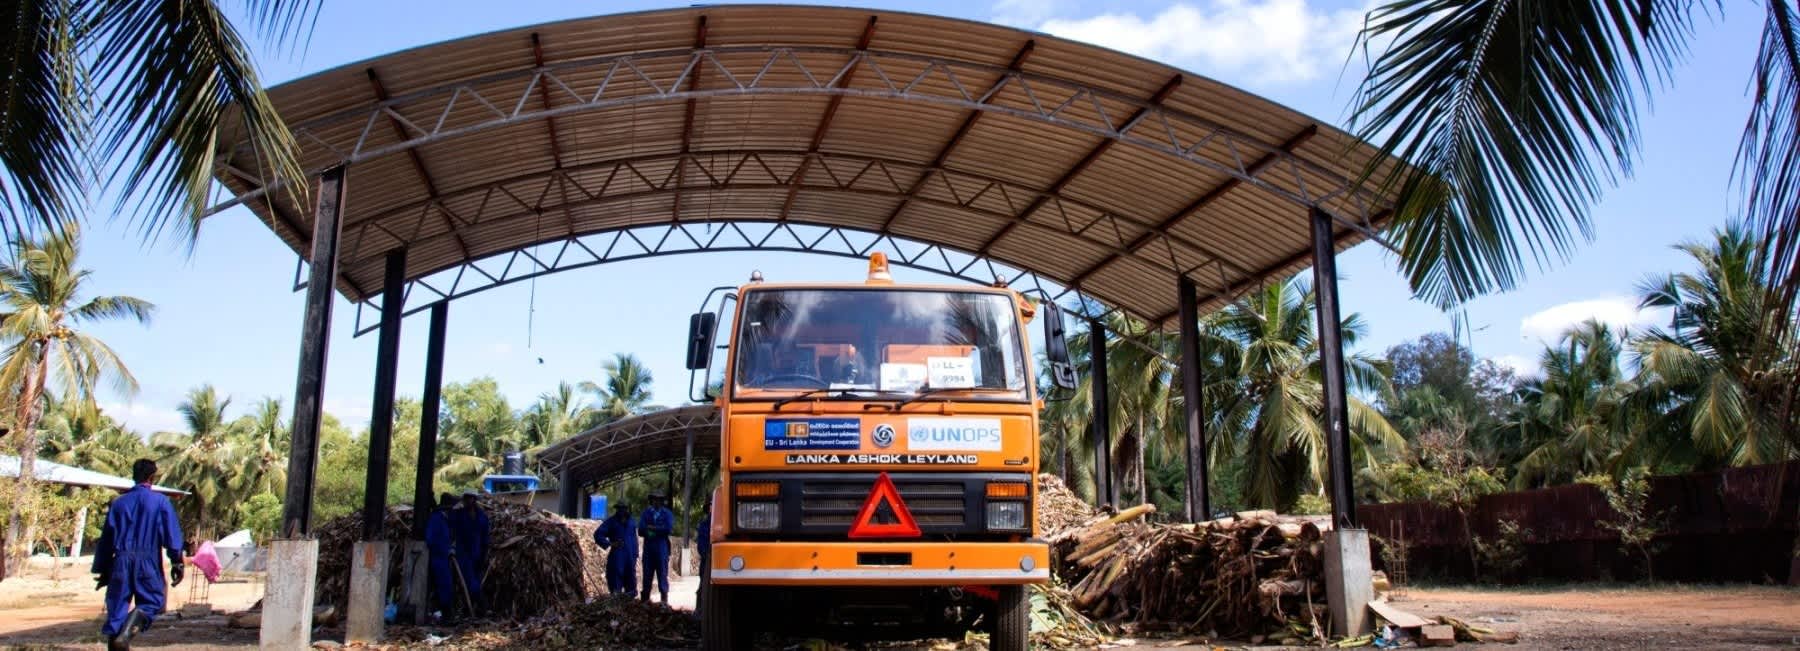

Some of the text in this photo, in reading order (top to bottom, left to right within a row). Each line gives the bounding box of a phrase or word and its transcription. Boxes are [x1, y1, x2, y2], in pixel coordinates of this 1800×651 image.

[931, 427, 1001, 442] UNOPS
[787, 454, 978, 464] LANKA ASHOK LEYLAND
